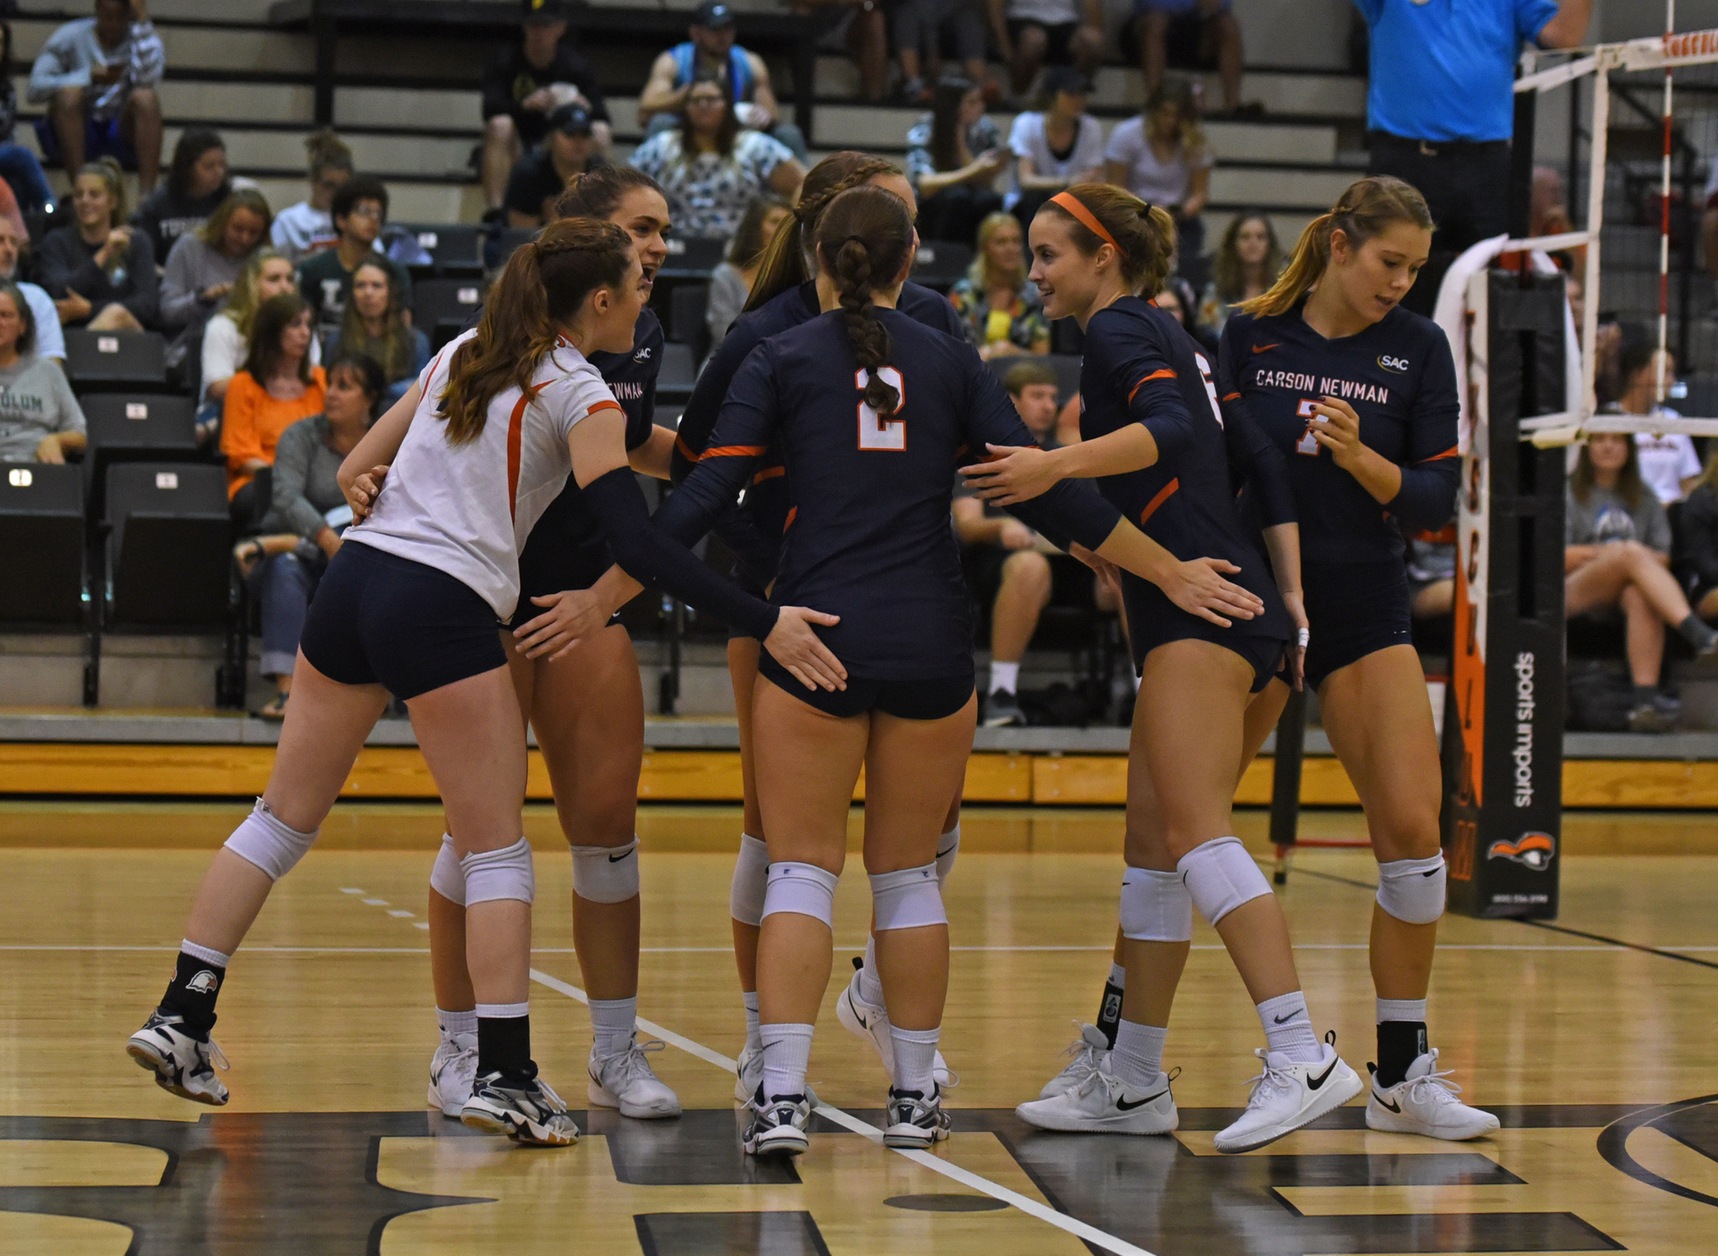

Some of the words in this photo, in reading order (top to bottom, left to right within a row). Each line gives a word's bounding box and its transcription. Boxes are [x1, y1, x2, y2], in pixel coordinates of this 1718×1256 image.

[1256, 369, 1315, 392] CARSON
[1319, 376, 1389, 405] NEWMAN
[1381, 355, 1409, 371] SAC
[855, 365, 906, 451] 2
[1514, 651, 1536, 722] sports
[1512, 723, 1535, 808] imports
